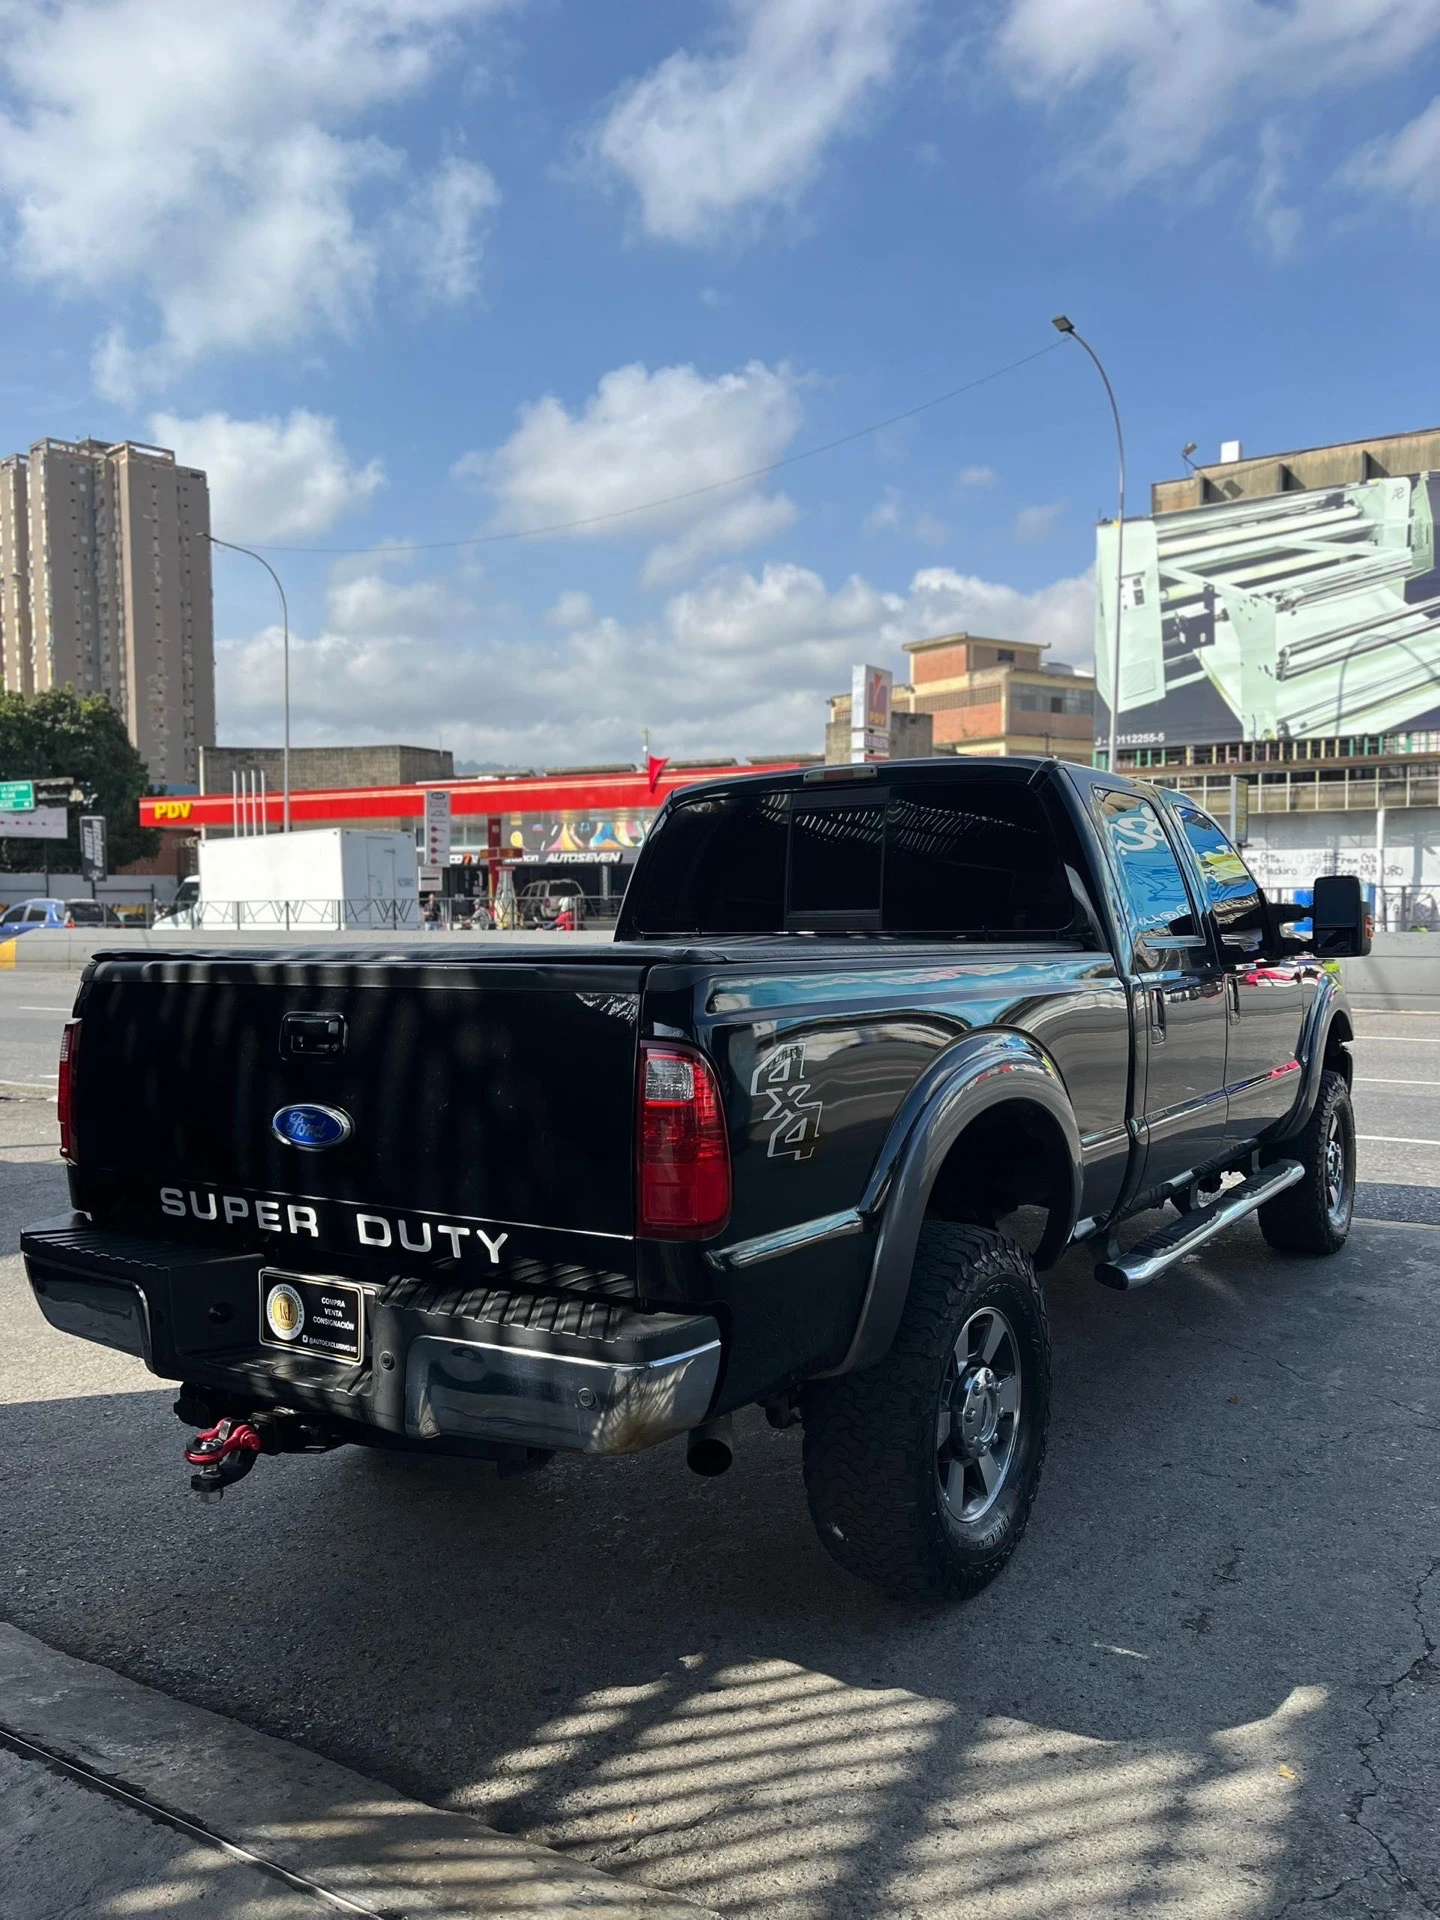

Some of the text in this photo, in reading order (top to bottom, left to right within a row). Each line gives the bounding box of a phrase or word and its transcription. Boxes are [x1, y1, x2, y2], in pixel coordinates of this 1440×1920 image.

[154, 802, 193, 819] PDV
[546, 851, 621, 864] AUTOSEVEN
[1360, 864, 1404, 877] MAURO
[285, 1110, 326, 1139] Ford
[160, 1187, 508, 1264] SUPER DUTY
[321, 1297, 346, 1308] COMPRA
[324, 1307, 343, 1318] VENTA
